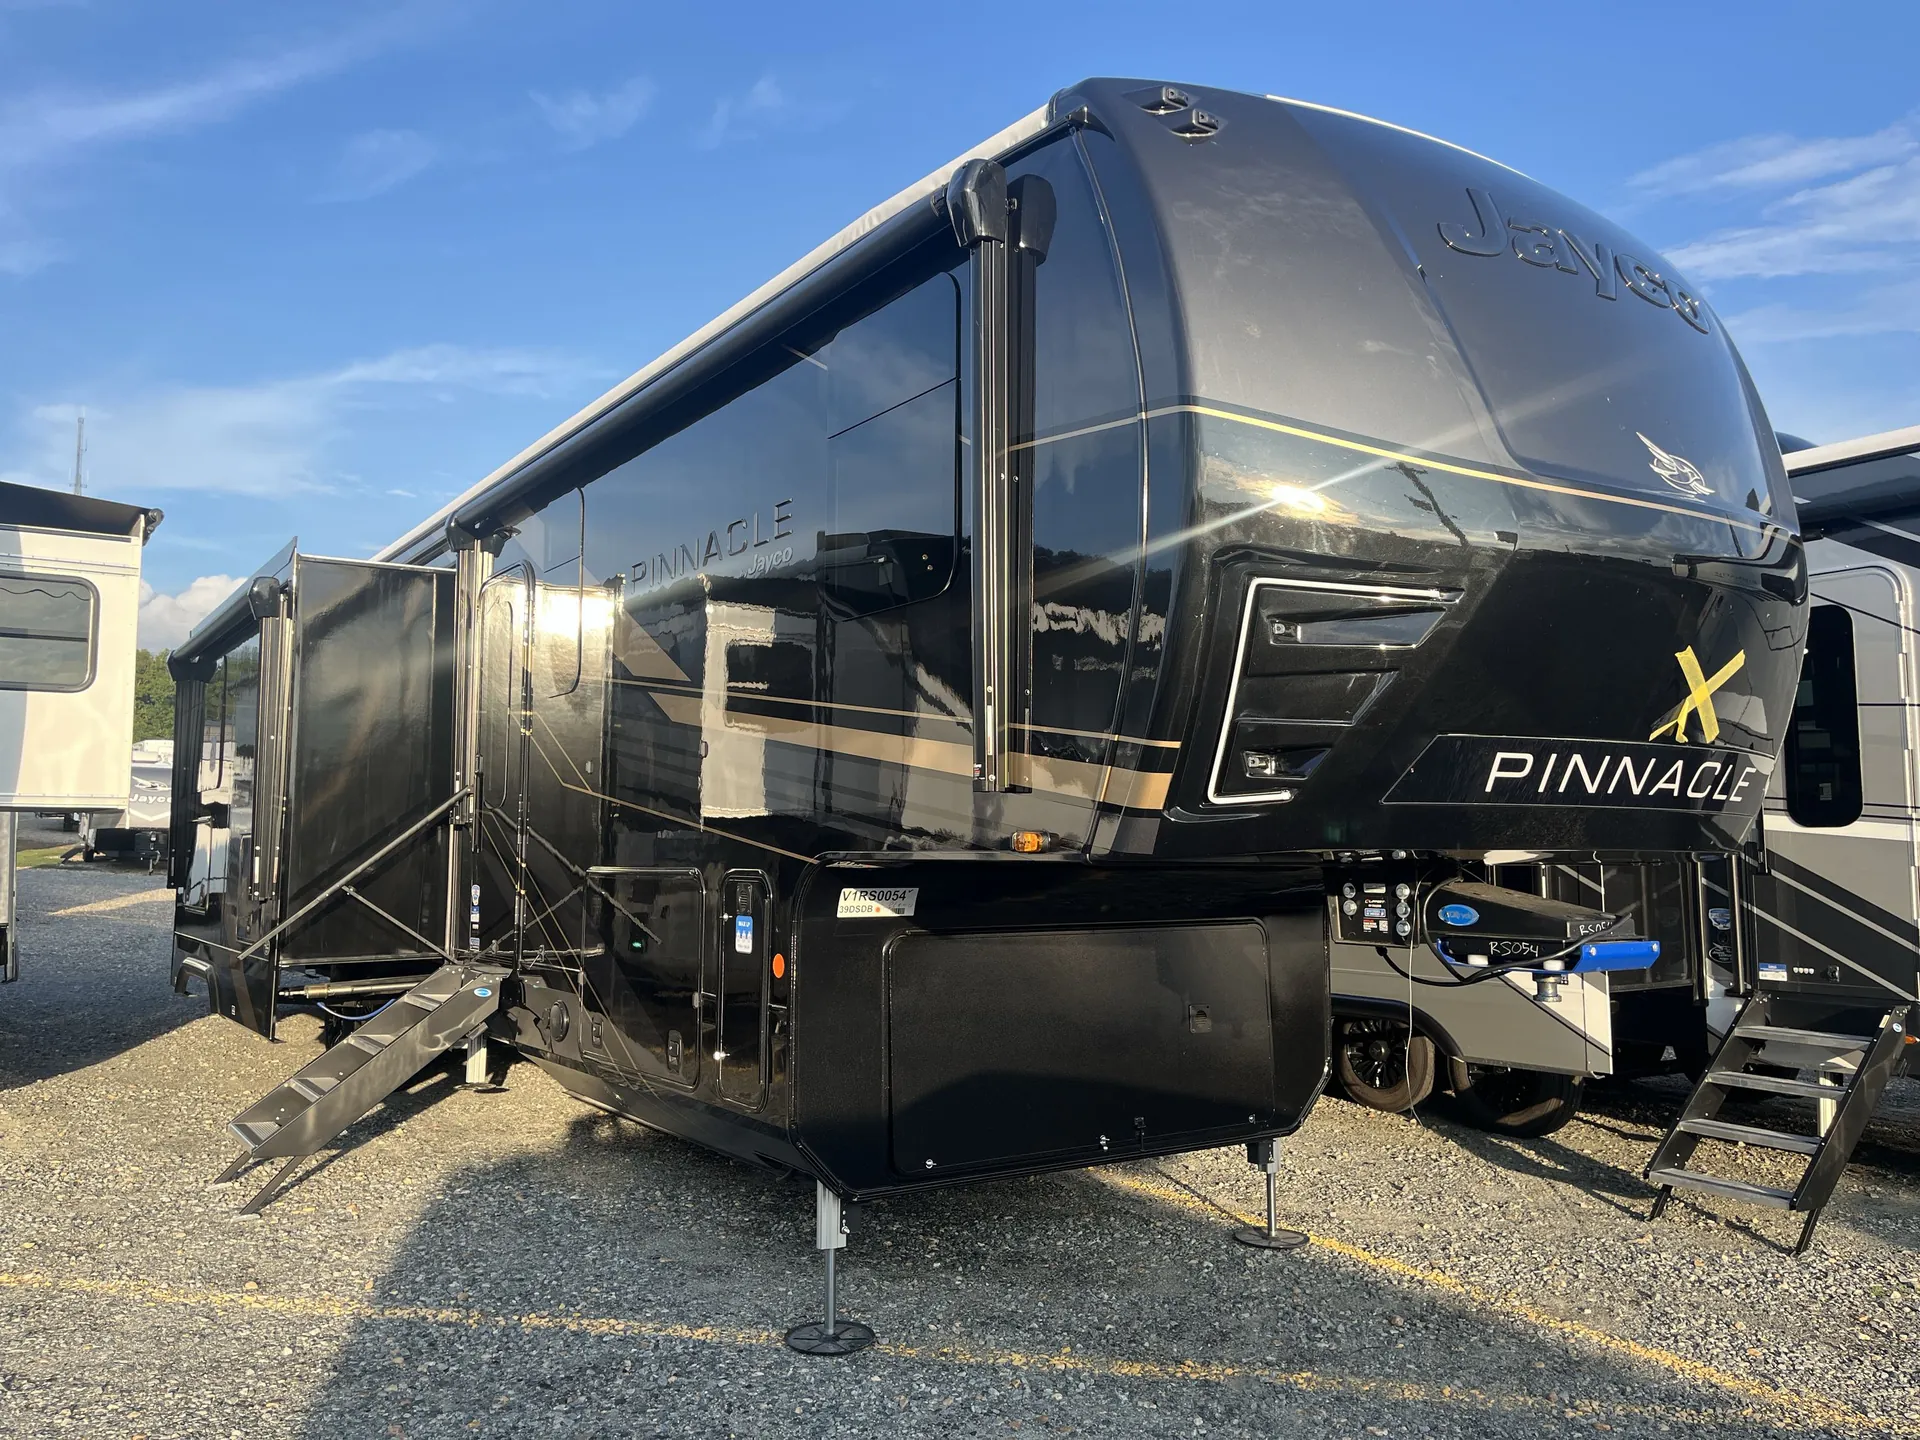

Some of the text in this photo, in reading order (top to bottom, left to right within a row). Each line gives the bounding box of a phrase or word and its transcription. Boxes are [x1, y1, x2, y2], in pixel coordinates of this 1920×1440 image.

[1437, 187, 1711, 335] Jayco
[631, 497, 794, 595] PINNACLE
[747, 546, 794, 577] Jayco
[1484, 751, 1757, 802] PINNACLE
[839, 905, 873, 914] 39DSDB
[842, 890, 907, 901] V1RS0054
[1489, 941, 1539, 957] RS054
